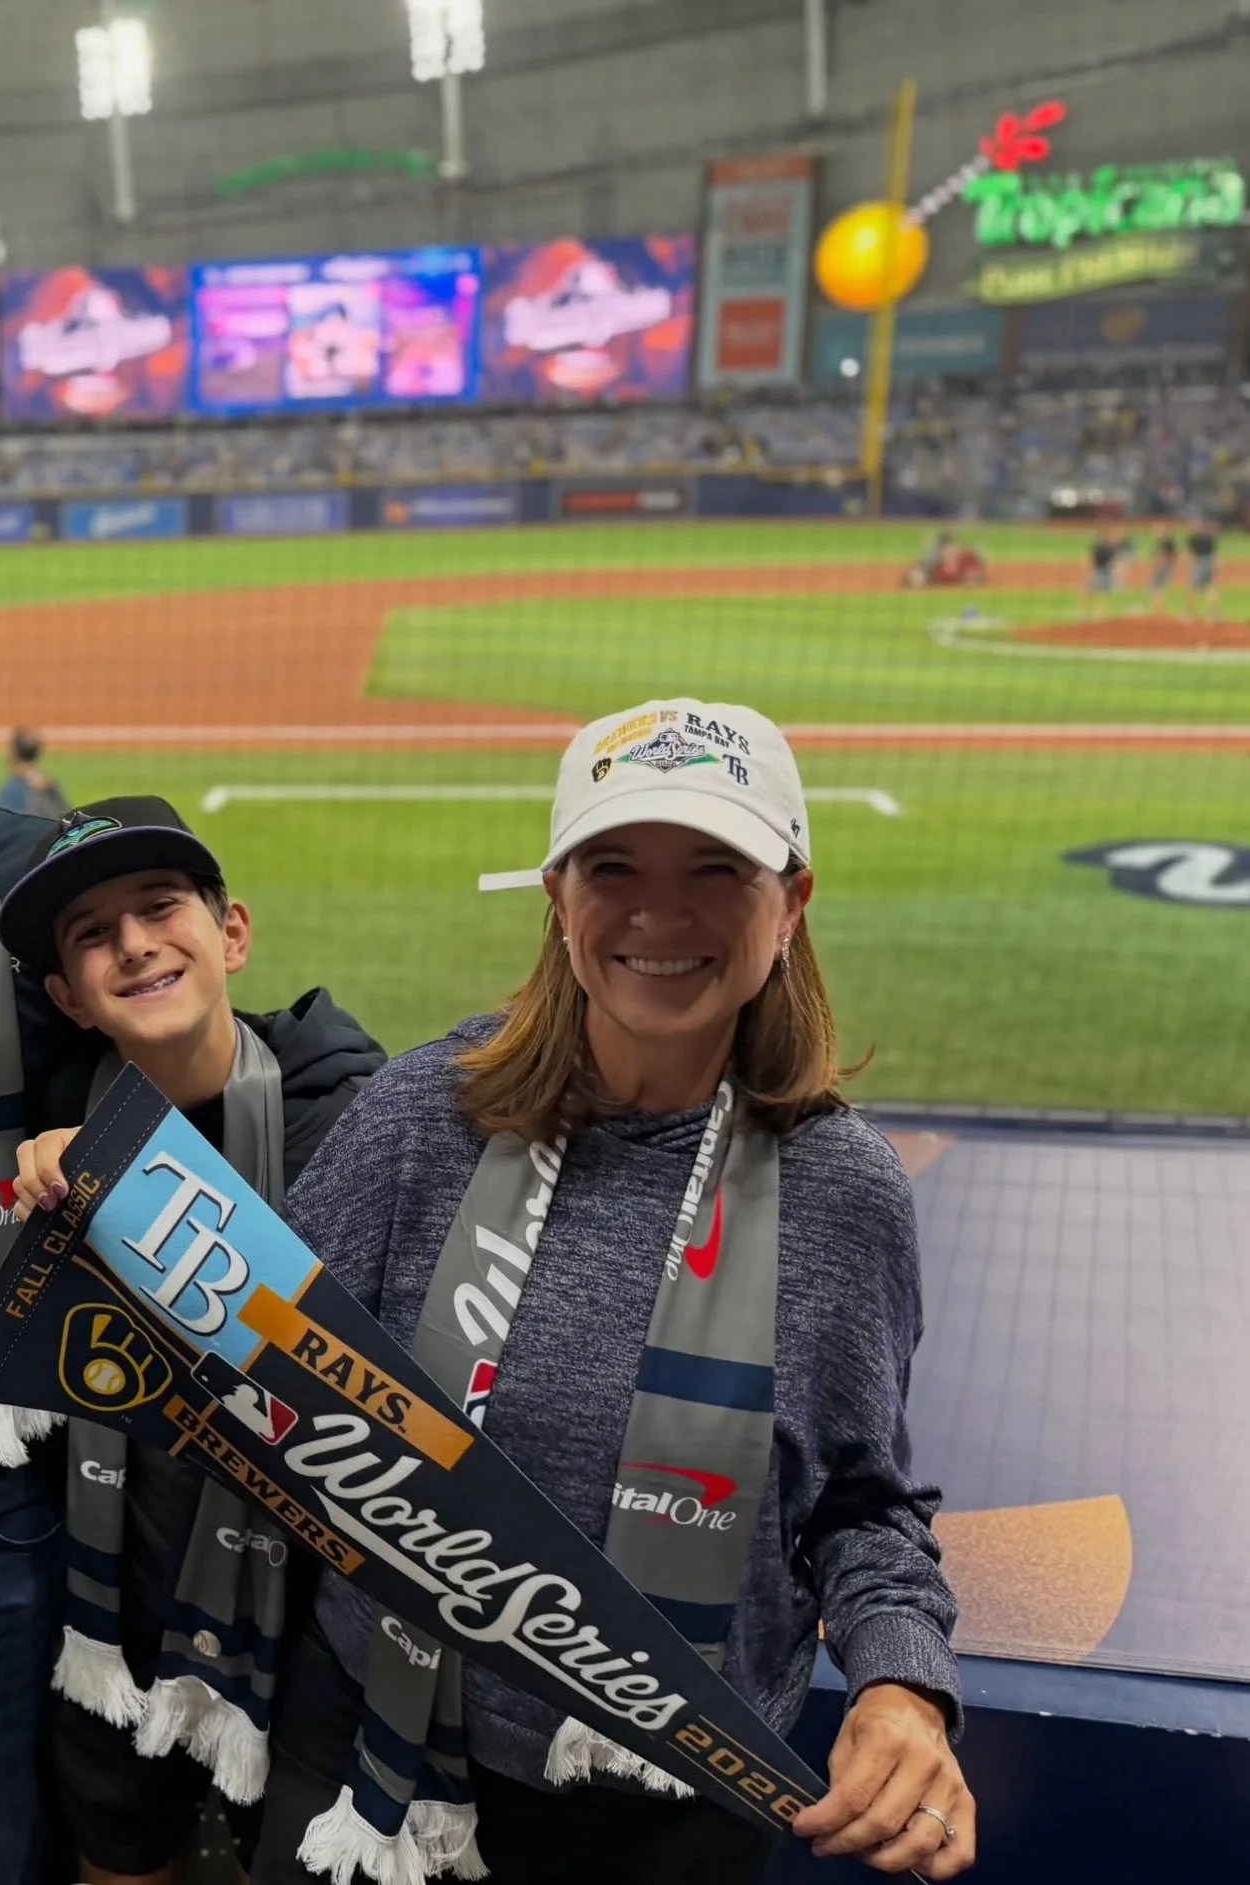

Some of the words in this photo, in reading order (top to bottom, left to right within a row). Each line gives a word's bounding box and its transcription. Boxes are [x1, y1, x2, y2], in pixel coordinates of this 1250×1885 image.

[684, 725, 713, 741] TAMPA
[687, 713, 750, 755] RAYS
[6, 1264, 53, 1319] FALL
[43, 1171, 100, 1254] CLASSIC
[122, 1151, 249, 1337] TB
[291, 1328, 412, 1425] RAYS
[174, 1406, 349, 1563] BREWERS
[284, 1413, 538, 1600] World
[438, 1573, 688, 1730] Series
[675, 1723, 806, 1822] 2026
